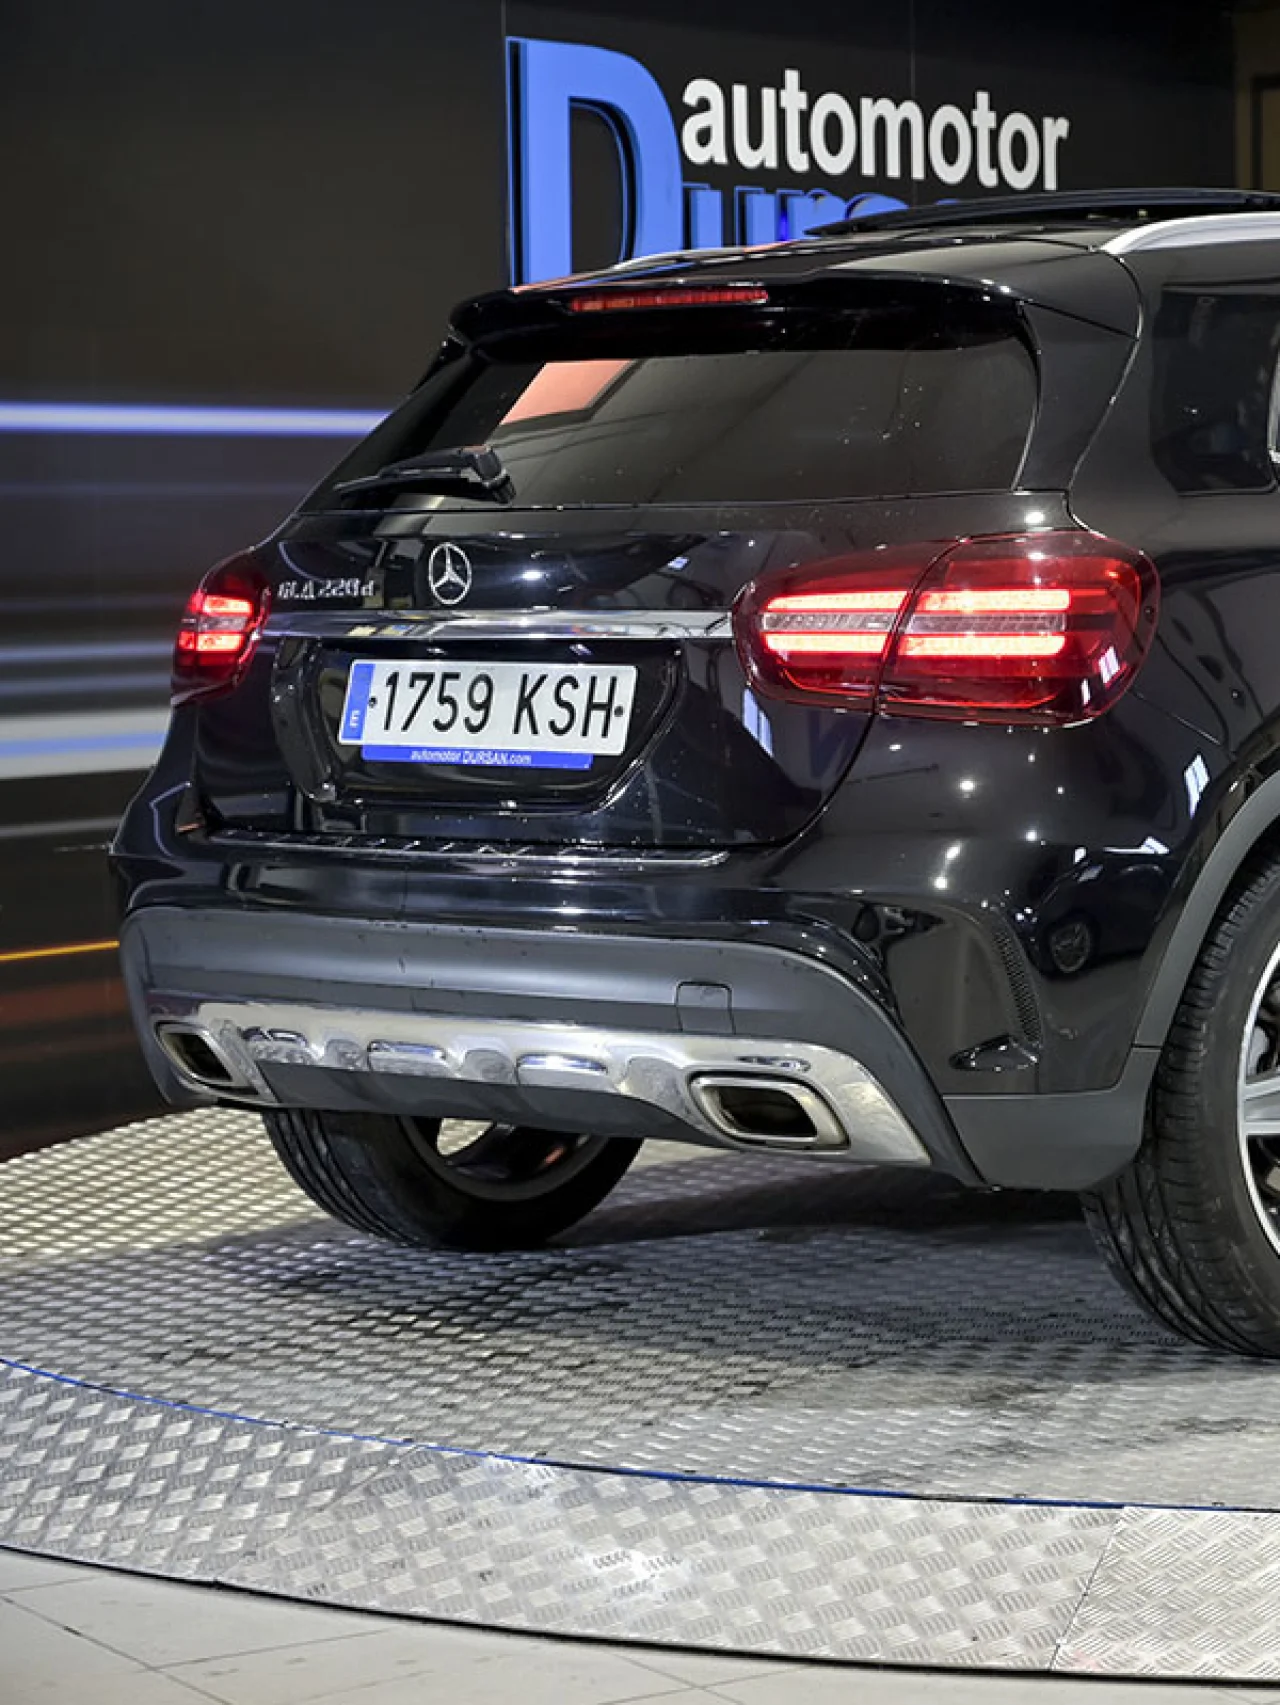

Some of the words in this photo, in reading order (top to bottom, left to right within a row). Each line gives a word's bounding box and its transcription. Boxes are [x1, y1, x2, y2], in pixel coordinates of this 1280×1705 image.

[681, 68, 1069, 190] automotor
[383, 671, 494, 733] 1759
[512, 673, 617, 739] KSH
[411, 750, 461, 763] automotor
[462, 750, 531, 766] DURSAN.com
